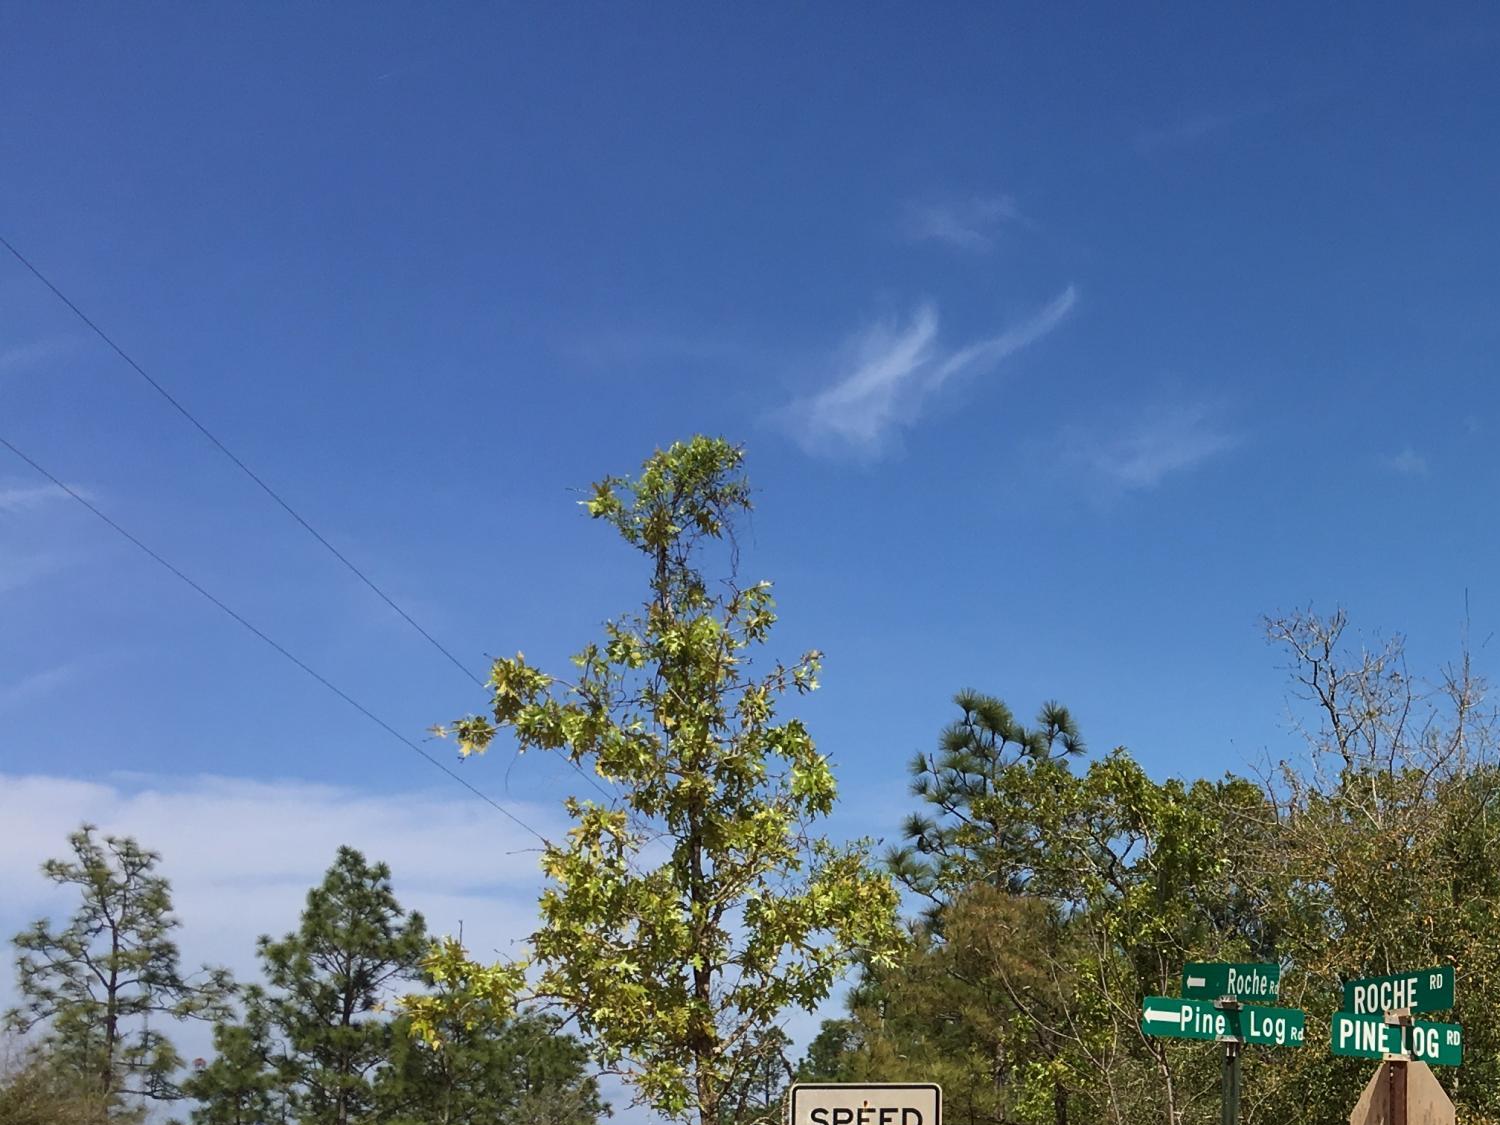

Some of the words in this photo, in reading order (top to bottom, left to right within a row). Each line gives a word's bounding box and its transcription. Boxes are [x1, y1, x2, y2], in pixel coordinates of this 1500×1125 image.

[1228, 968, 1267, 995] Roche
[1354, 978, 1418, 1014] ROCHE
[1430, 974, 1443, 990] RD
[1181, 1005, 1225, 1034] Pine
[1250, 1011, 1286, 1044] Log
[1291, 1027, 1304, 1041] Rd
[1339, 1018, 1389, 1052] PINE
[1446, 1029, 1461, 1046] RD
